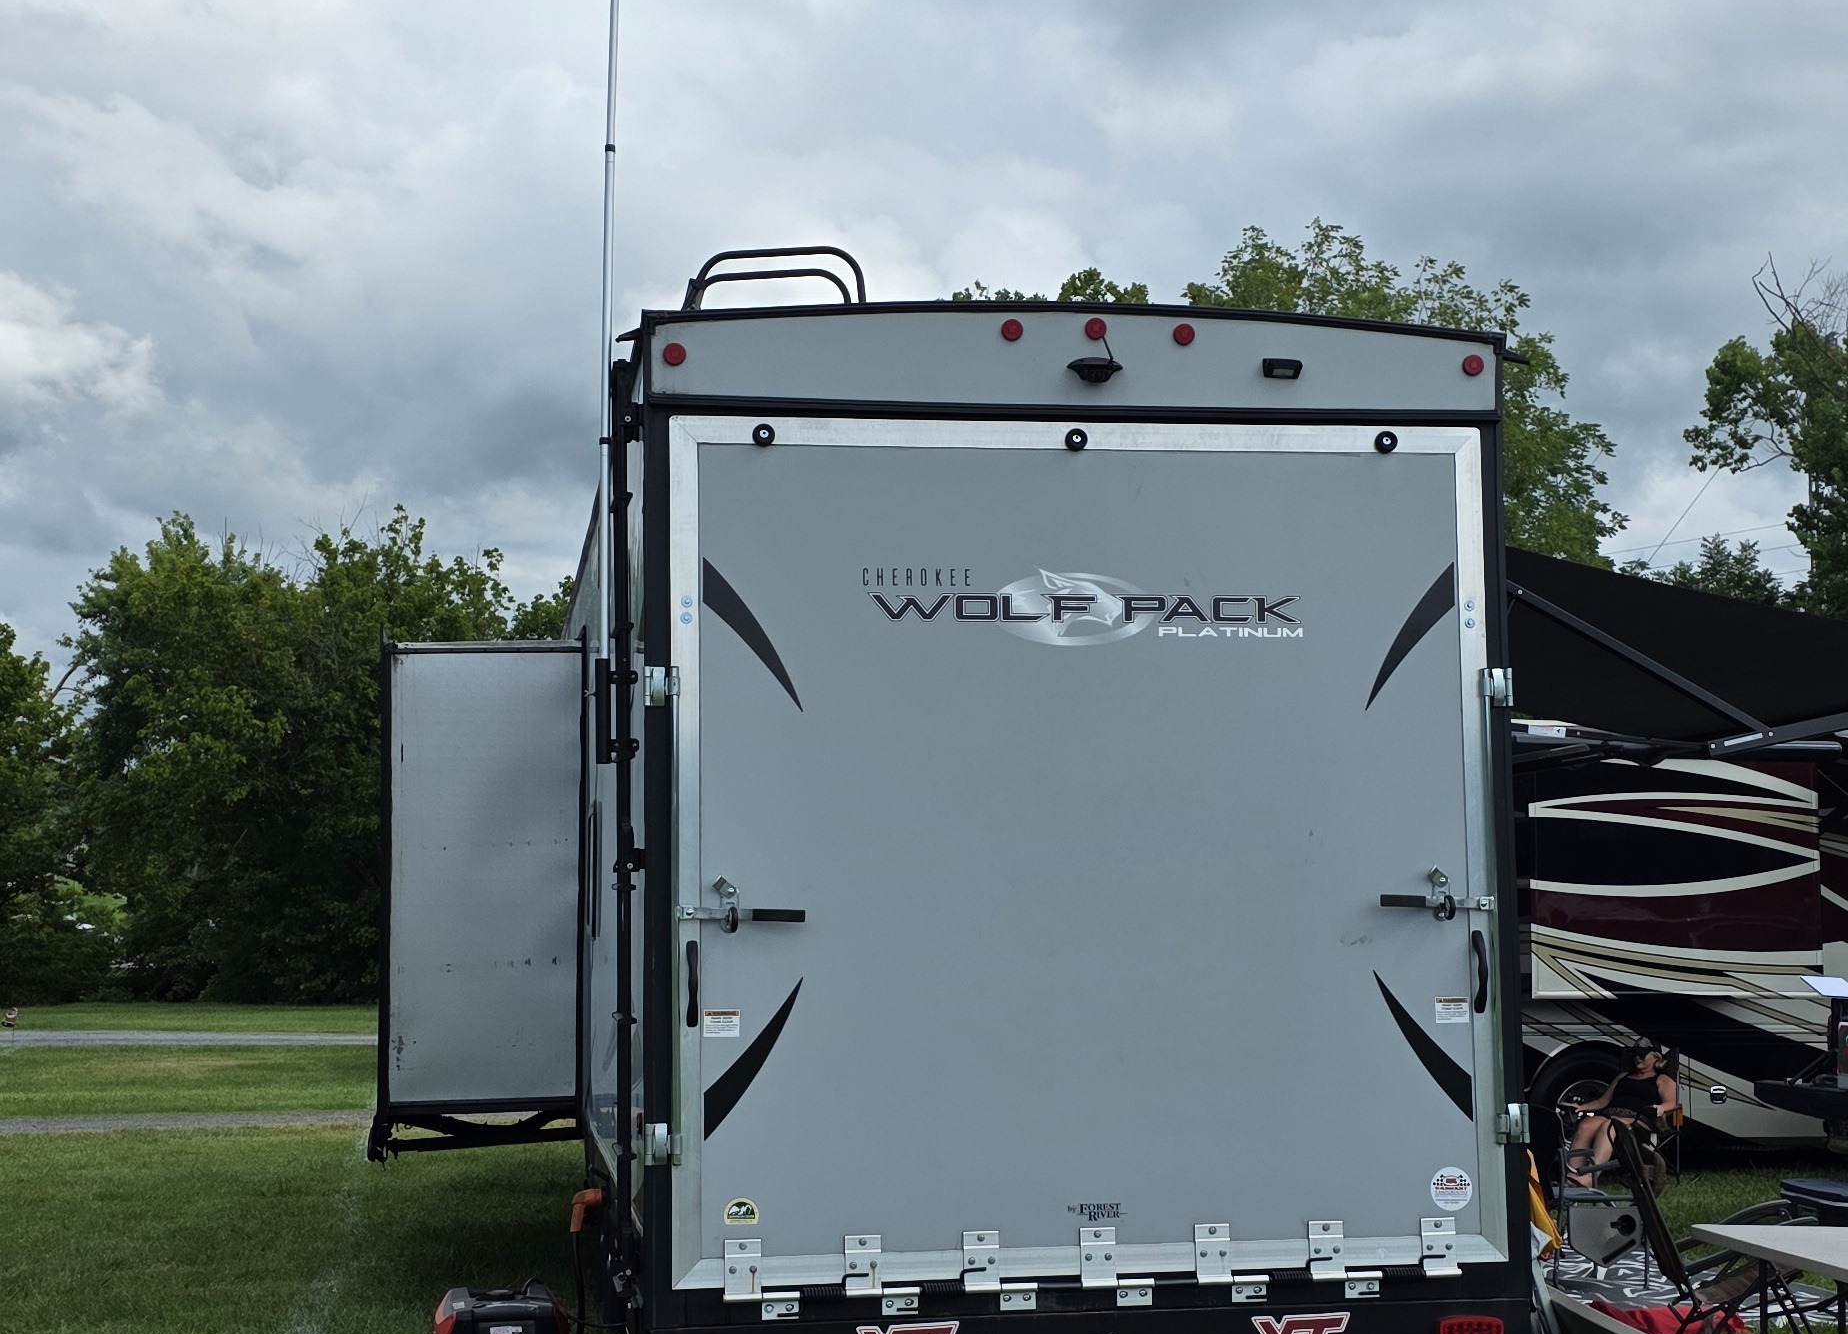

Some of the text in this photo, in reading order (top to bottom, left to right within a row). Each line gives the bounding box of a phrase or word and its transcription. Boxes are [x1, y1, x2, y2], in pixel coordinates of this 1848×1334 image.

[862, 567, 971, 587] CHEROKEE
[867, 591, 1301, 624] WOLF PACK
[1158, 626, 1304, 638] PLATINUM
